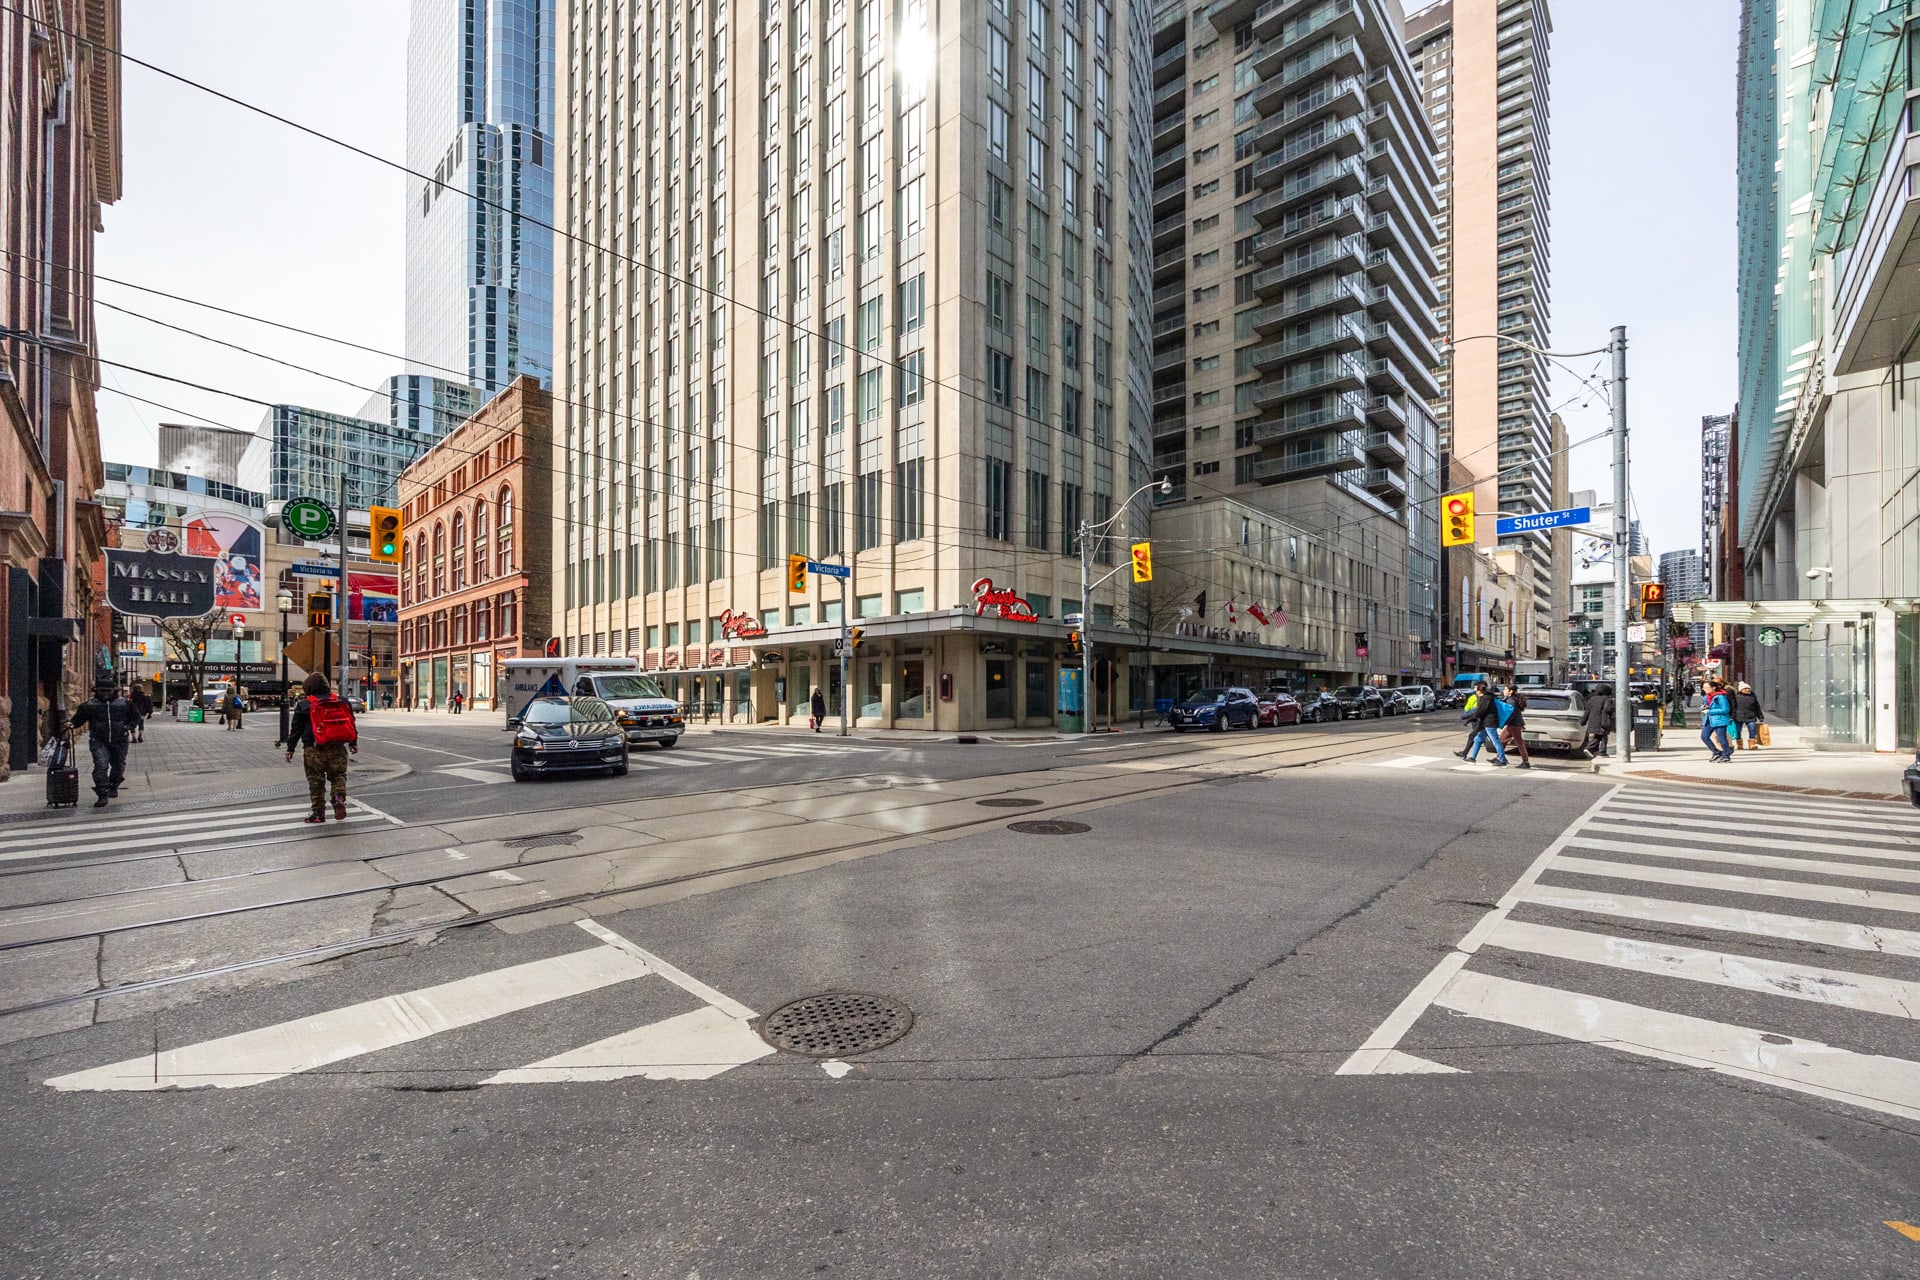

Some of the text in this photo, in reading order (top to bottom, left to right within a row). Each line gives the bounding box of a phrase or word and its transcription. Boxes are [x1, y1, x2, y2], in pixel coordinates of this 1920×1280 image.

[300, 507, 321, 525] P
[1514, 515, 1560, 530] Shuter
[112, 560, 209, 583] MASSEY
[299, 566, 326, 574] Victoria
[814, 564, 840, 575] Victoria
[129, 585, 193, 604] HALL
[1233, 629, 1260, 644] HOTEL
[245, 665, 273, 673] Centre
[515, 683, 538, 692] AMBULANCE
